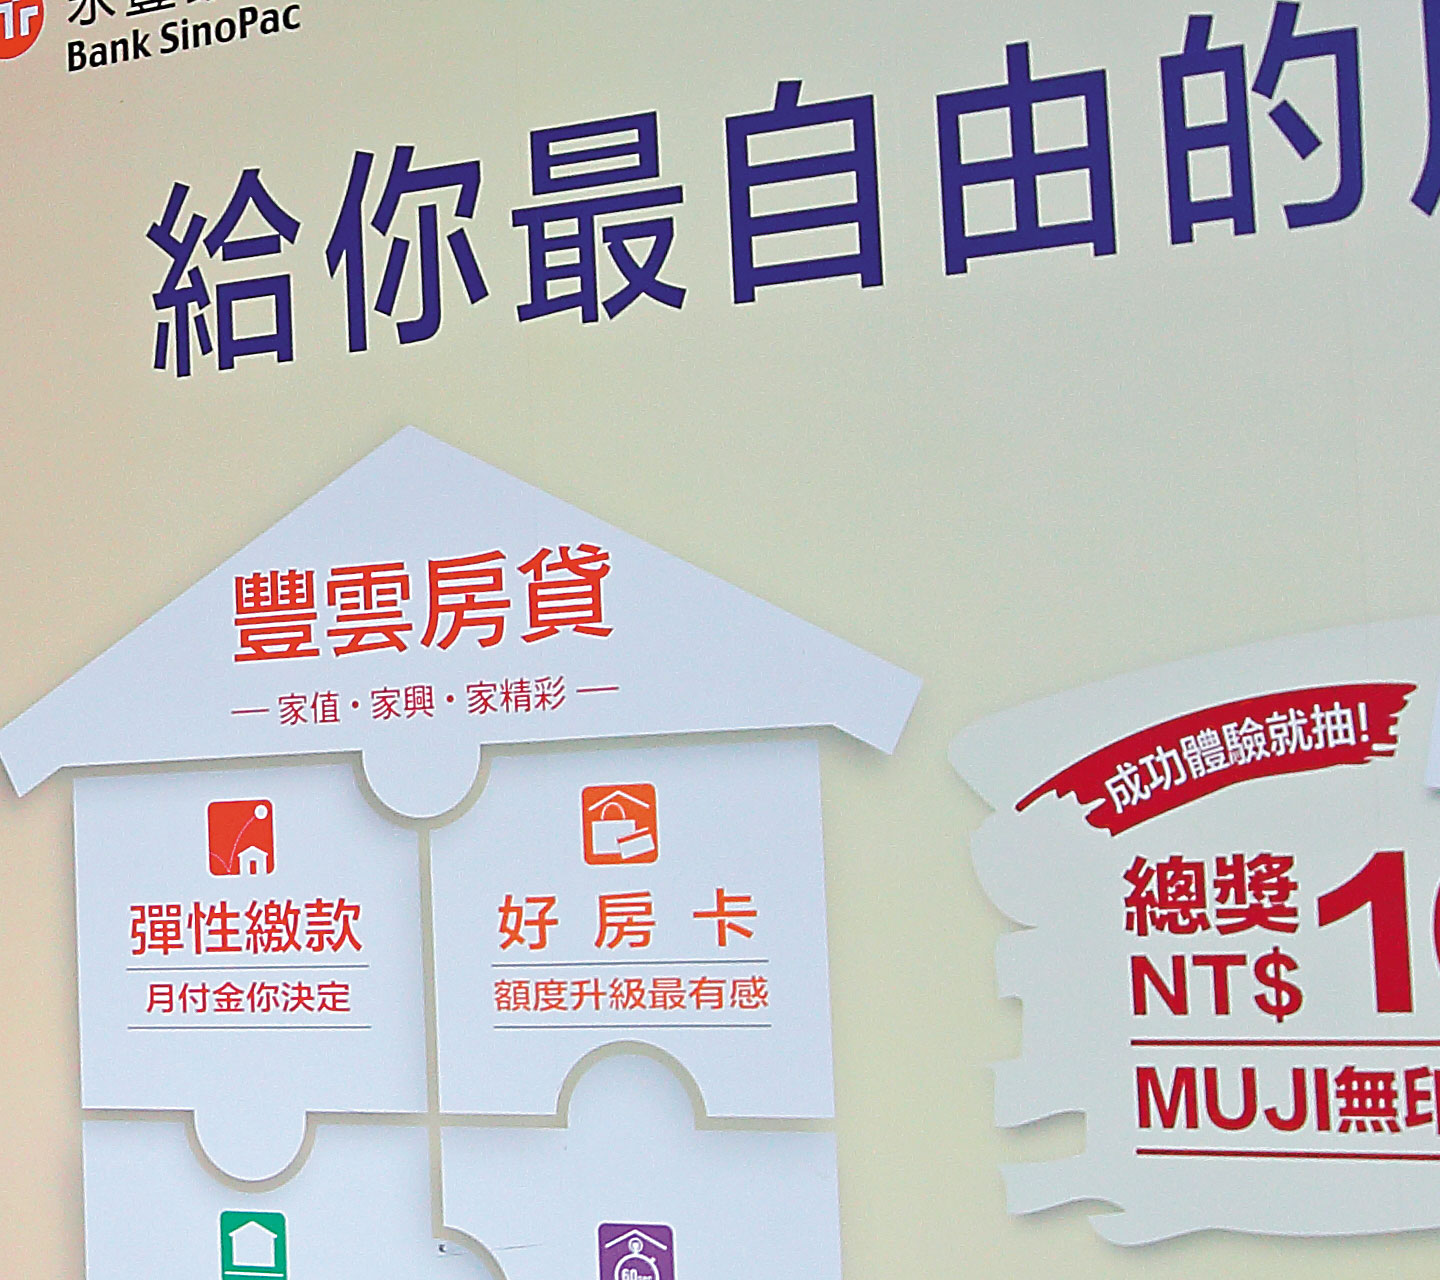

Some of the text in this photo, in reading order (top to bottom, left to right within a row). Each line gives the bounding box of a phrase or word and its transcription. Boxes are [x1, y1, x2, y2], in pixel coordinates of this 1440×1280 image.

[67, 3, 301, 72] Bank SinoPac
[231, 542, 616, 664] 豐雲房貸
[1104, 700, 1371, 813] 成功體驗就抽!
[128, 896, 363, 957] 彈性繳款
[497, 888, 759, 952] 好房卡
[1122, 852, 1301, 937] 總獎
[144, 979, 352, 1015] 月付金你決定
[493, 974, 770, 1012] 額度升級最有感
[1131, 946, 1304, 1022] NT$
